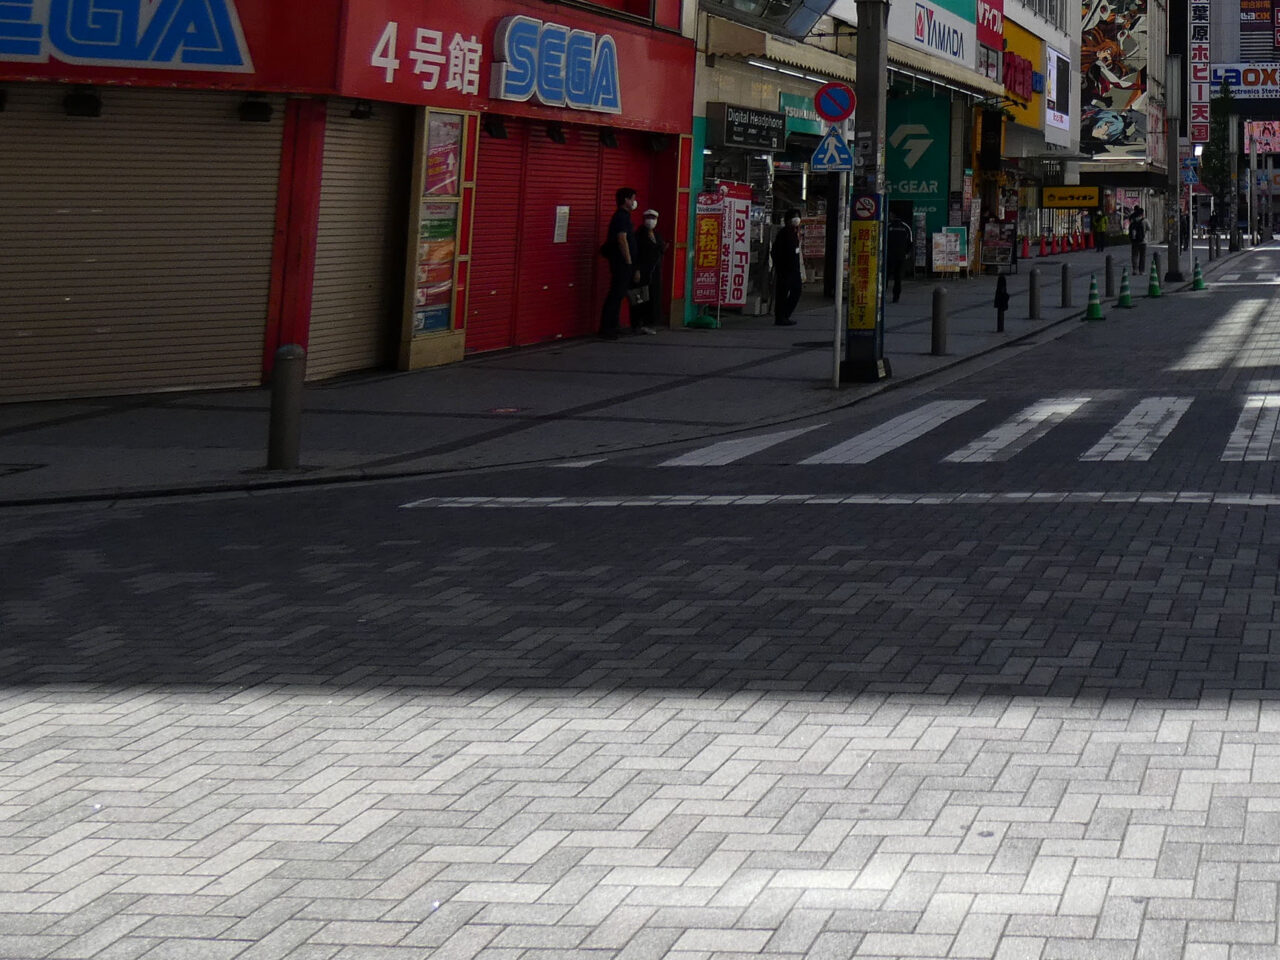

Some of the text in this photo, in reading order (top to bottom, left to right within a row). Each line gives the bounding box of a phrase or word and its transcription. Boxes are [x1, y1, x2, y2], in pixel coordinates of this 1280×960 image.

[925, 8, 965, 60] YAMADA
[984, 6, 1004, 35] アイフル
[370, 21, 483, 96] 4号館
[497, 15, 622, 115] SEGA
[728, 107, 783, 129] Digital Headphone
[732, 204, 749, 301] Tax Free
